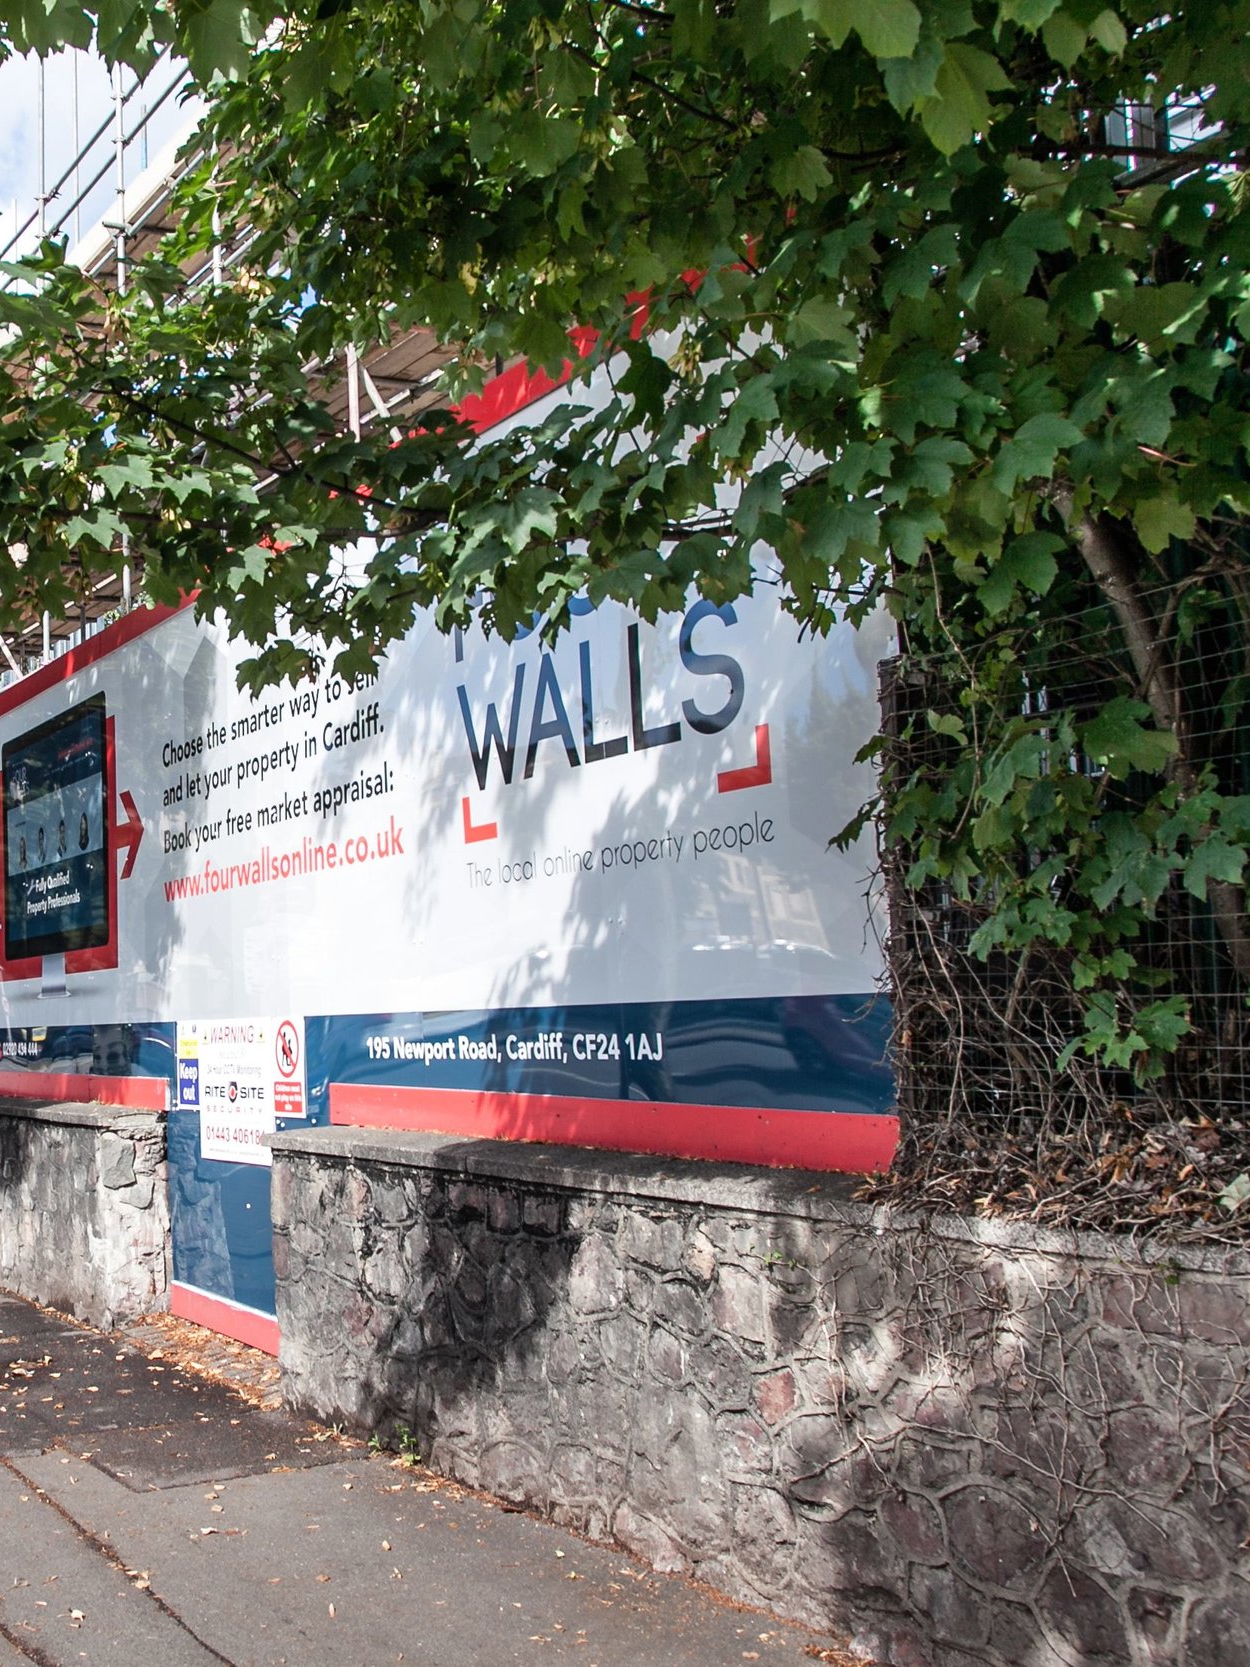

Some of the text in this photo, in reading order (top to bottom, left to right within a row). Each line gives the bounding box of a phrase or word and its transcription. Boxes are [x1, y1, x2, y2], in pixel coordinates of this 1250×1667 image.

[456, 600, 745, 791] WALLS
[162, 734, 203, 768] Choose
[206, 722, 227, 749] the
[231, 703, 285, 741] smarter
[289, 688, 320, 718] way
[325, 679, 341, 704] to
[162, 702, 385, 807] and let your property in Cardiff.
[163, 761, 395, 854] Book your free market appraisal:
[163, 815, 405, 903] www.fourwallsonline.co.uk
[466, 811, 775, 889] The local online property people
[36, 870, 70, 894] Fully Qualified
[27, 888, 80, 916] Property Professionals
[210, 1026, 254, 1044] WARNING
[366, 1032, 664, 1066] 195 Newport Road, Cardiff, CF24 1AJ
[180, 1063, 198, 1083] Keep
[183, 1085, 196, 1101] out
[205, 1086, 265, 1100] RITE SITE
[206, 1105, 262, 1114] SECURITY
[206, 1126, 230, 1142] 01443
